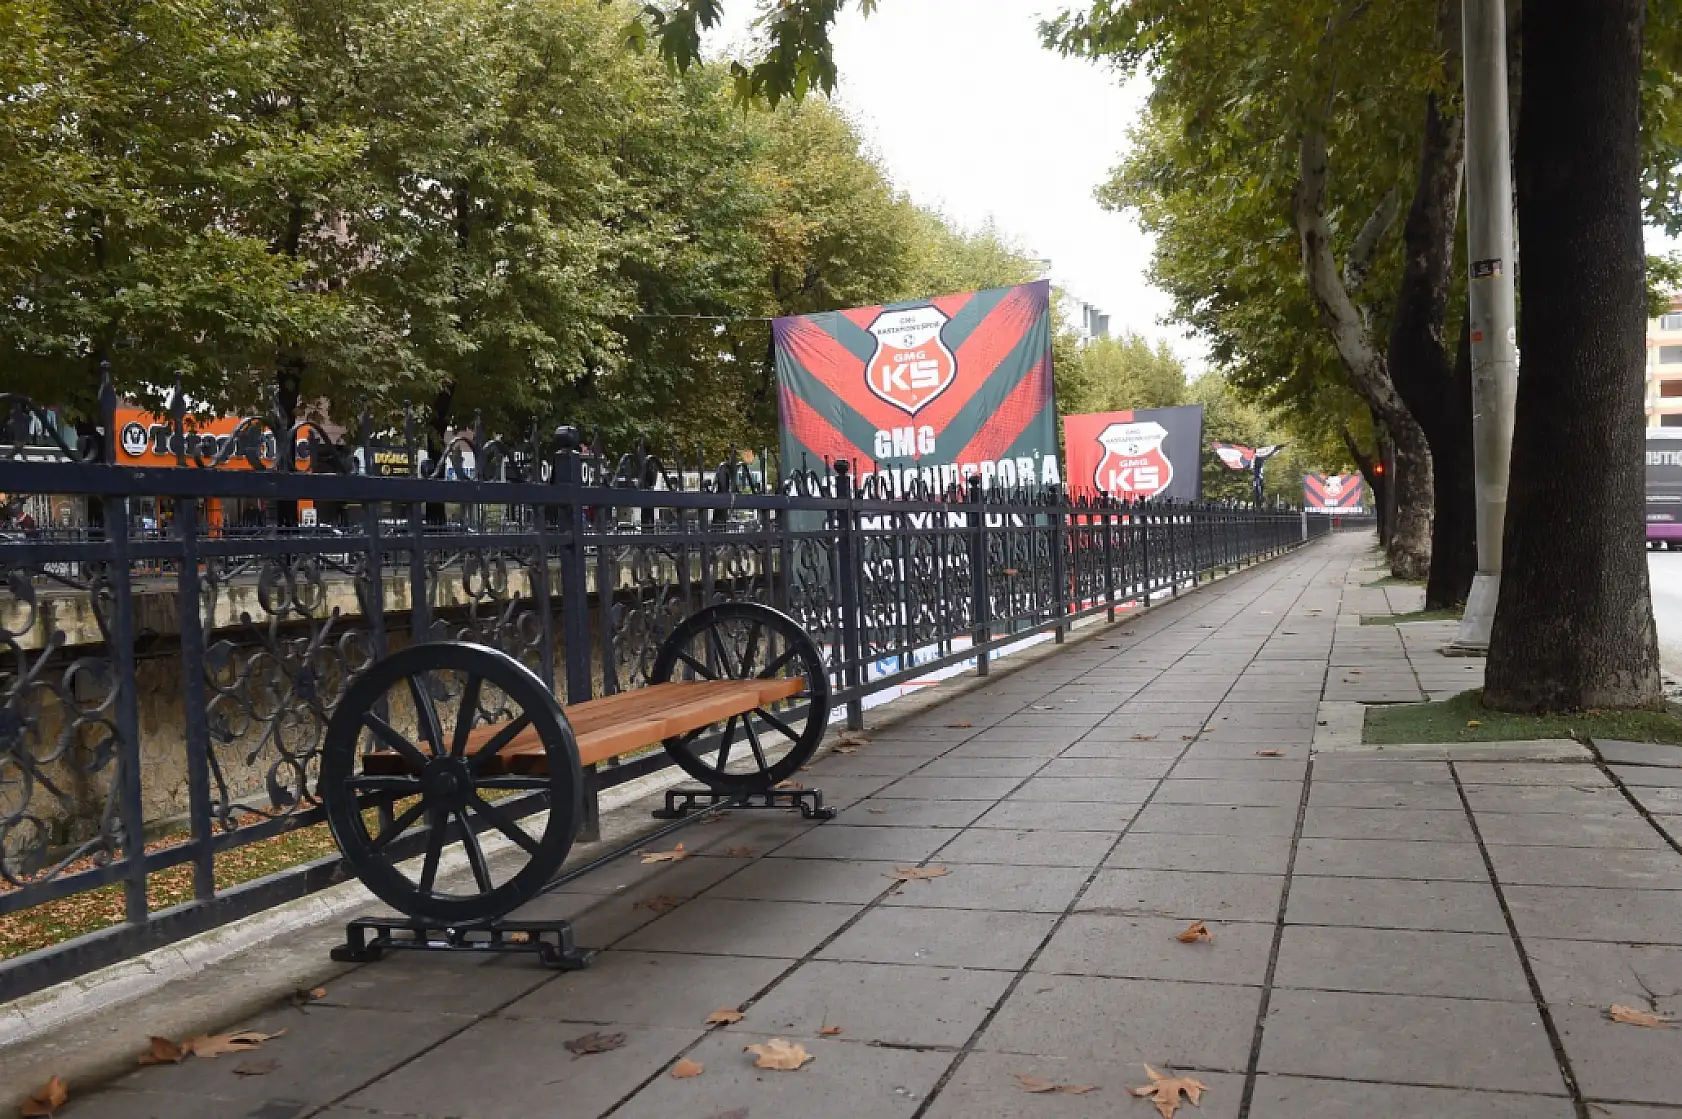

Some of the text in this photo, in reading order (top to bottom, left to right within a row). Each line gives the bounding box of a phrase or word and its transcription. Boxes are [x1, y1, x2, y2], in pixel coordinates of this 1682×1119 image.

[893, 350, 926, 363] GMG
[882, 359, 939, 393] KS
[874, 425, 936, 459] GMG
[1118, 457, 1148, 468] GMG
[1108, 465, 1159, 492] KS
